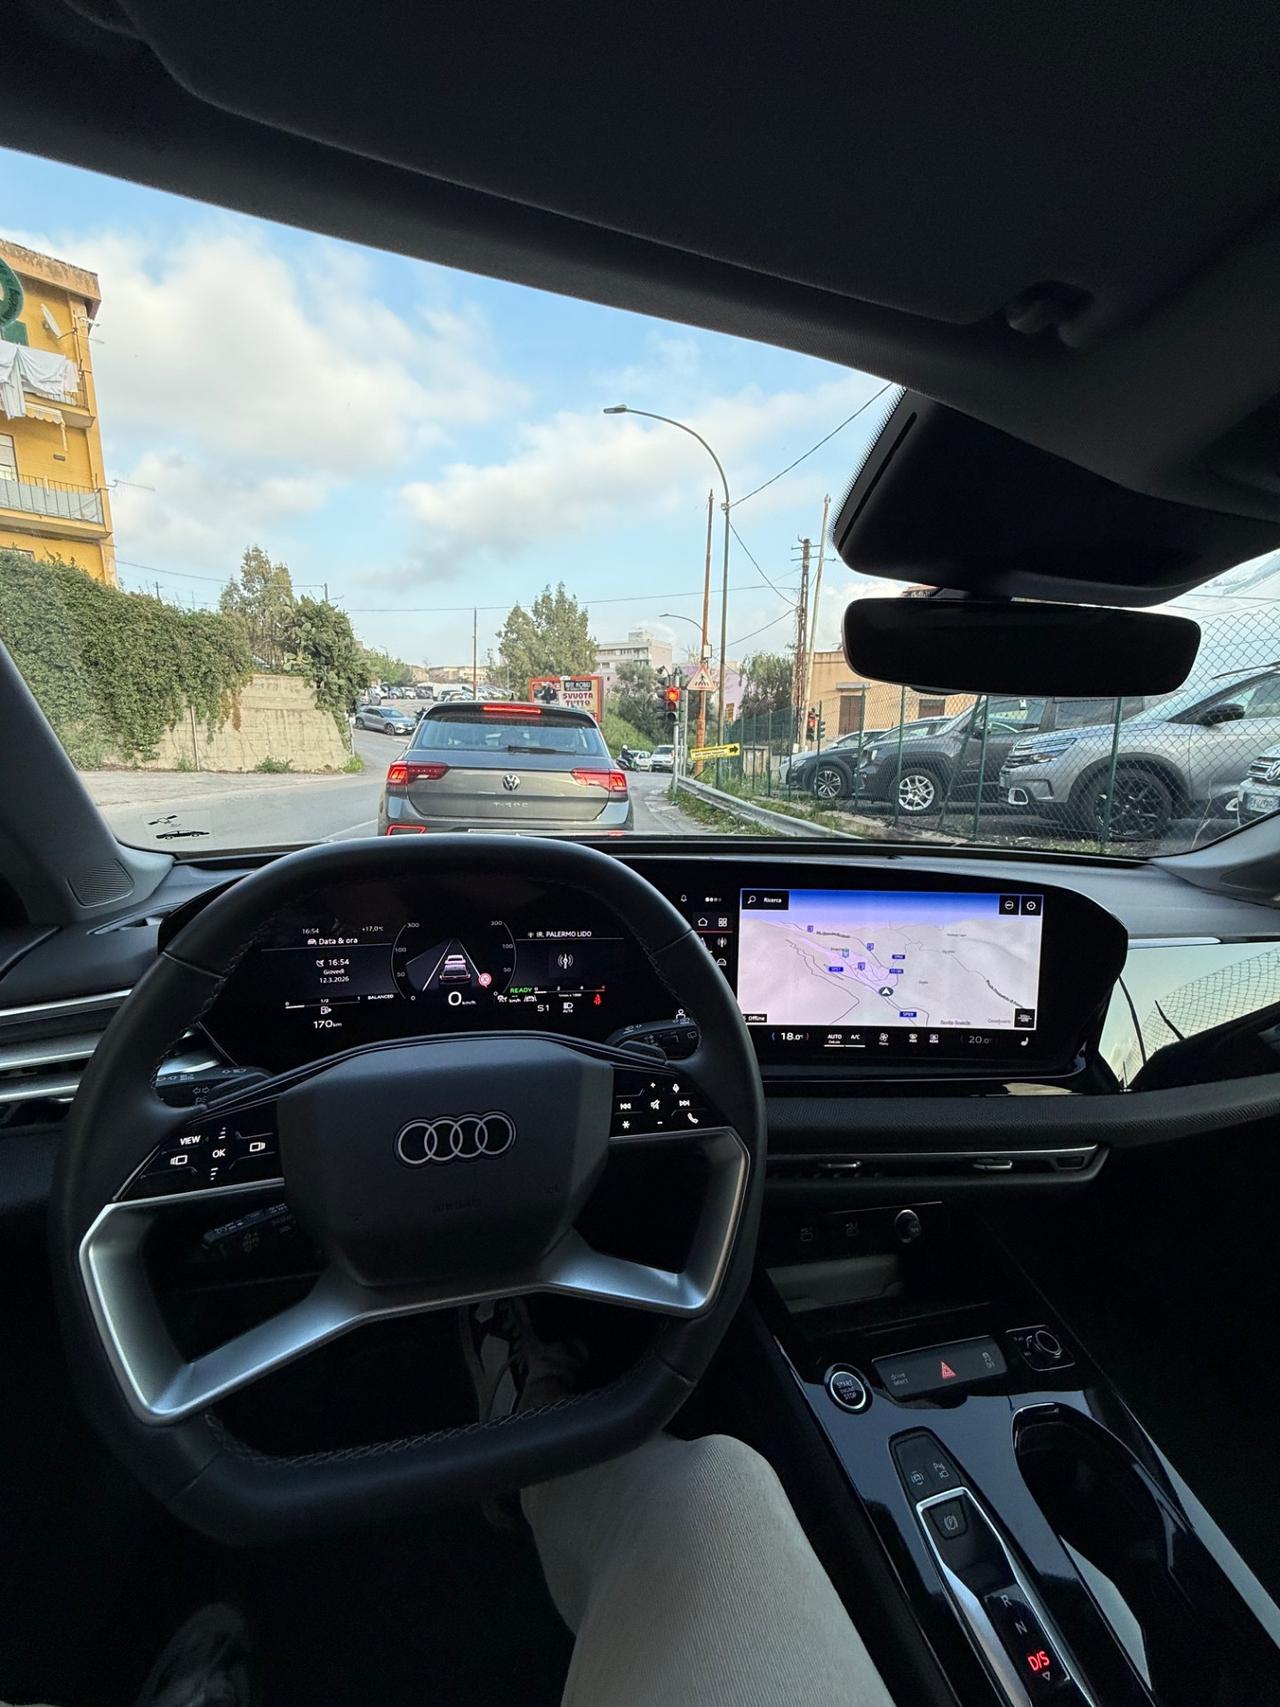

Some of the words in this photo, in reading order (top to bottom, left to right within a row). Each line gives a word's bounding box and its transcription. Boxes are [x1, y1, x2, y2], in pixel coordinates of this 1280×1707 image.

[447, 991, 462, 1006] 0
[313, 1020, 333, 1029] 170
[180, 1136, 201, 1146] VIEW
[212, 1149, 226, 1158] OK
[1000, 1594, 1012, 1607] R
[1015, 1620, 1028, 1634] N
[1027, 1650, 1050, 1671] D/S
